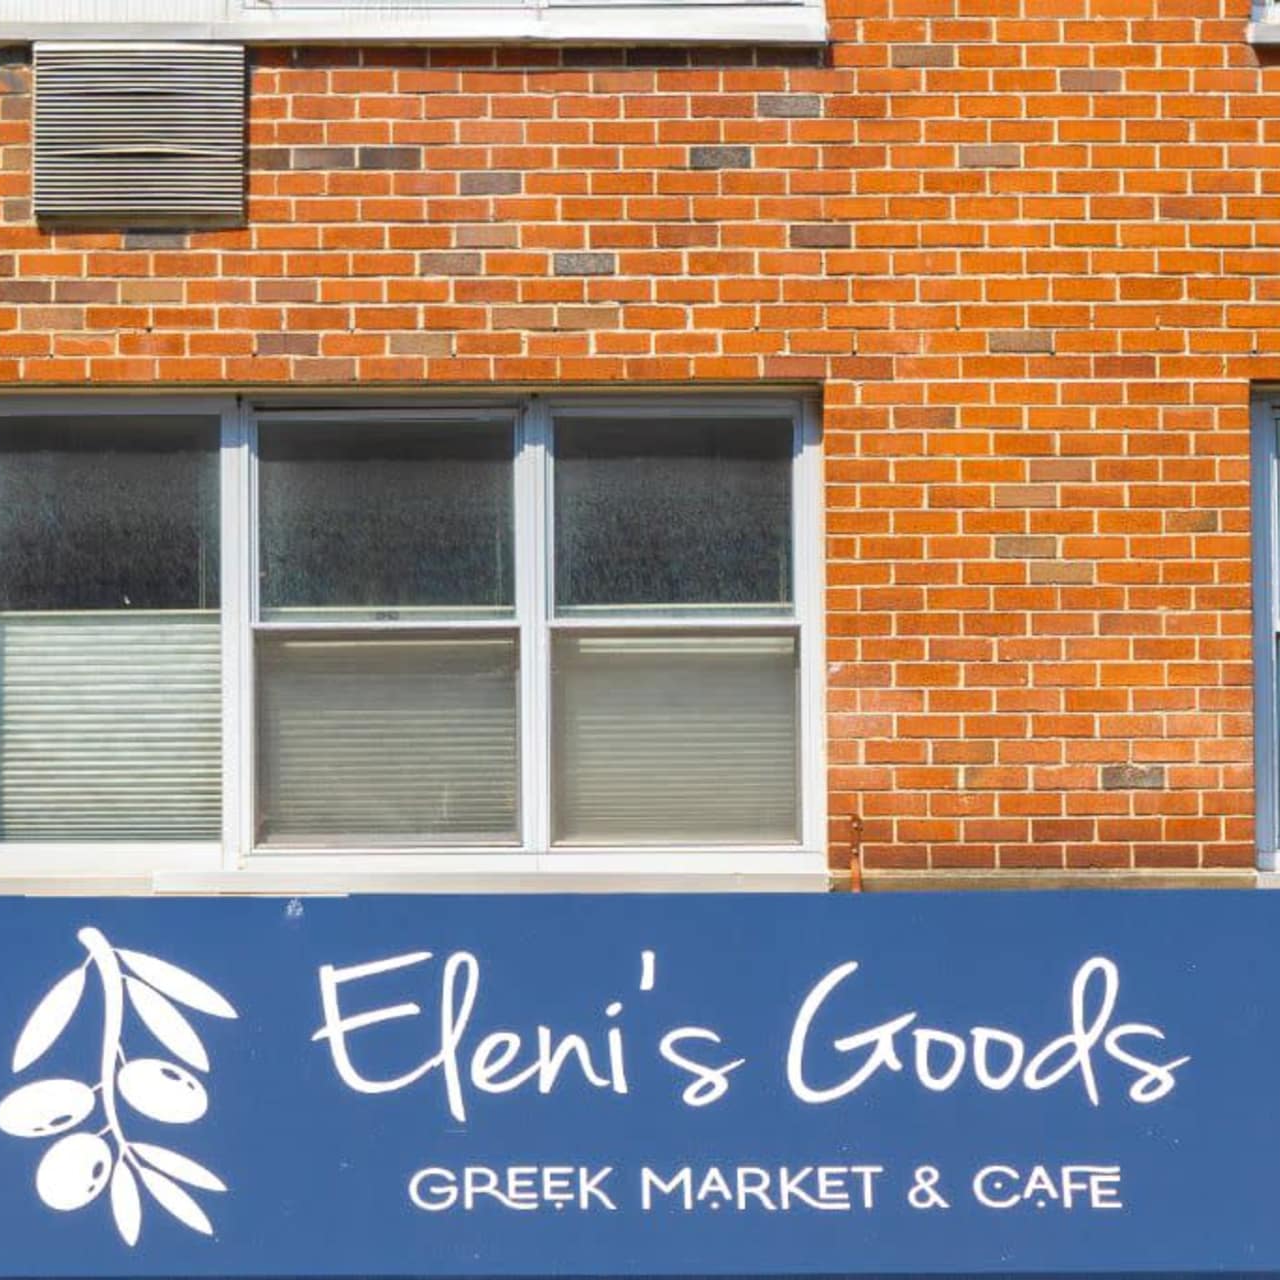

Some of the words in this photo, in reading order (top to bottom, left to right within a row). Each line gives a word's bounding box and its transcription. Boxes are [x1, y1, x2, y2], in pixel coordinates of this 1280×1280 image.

[312, 950, 746, 1121] Eleni's
[786, 956, 1191, 1107] Goods
[408, 1166, 617, 1211] GREEK
[641, 1165, 884, 1211] MARKET
[907, 1165, 950, 1209] &
[972, 1165, 1123, 1209] CAFE
